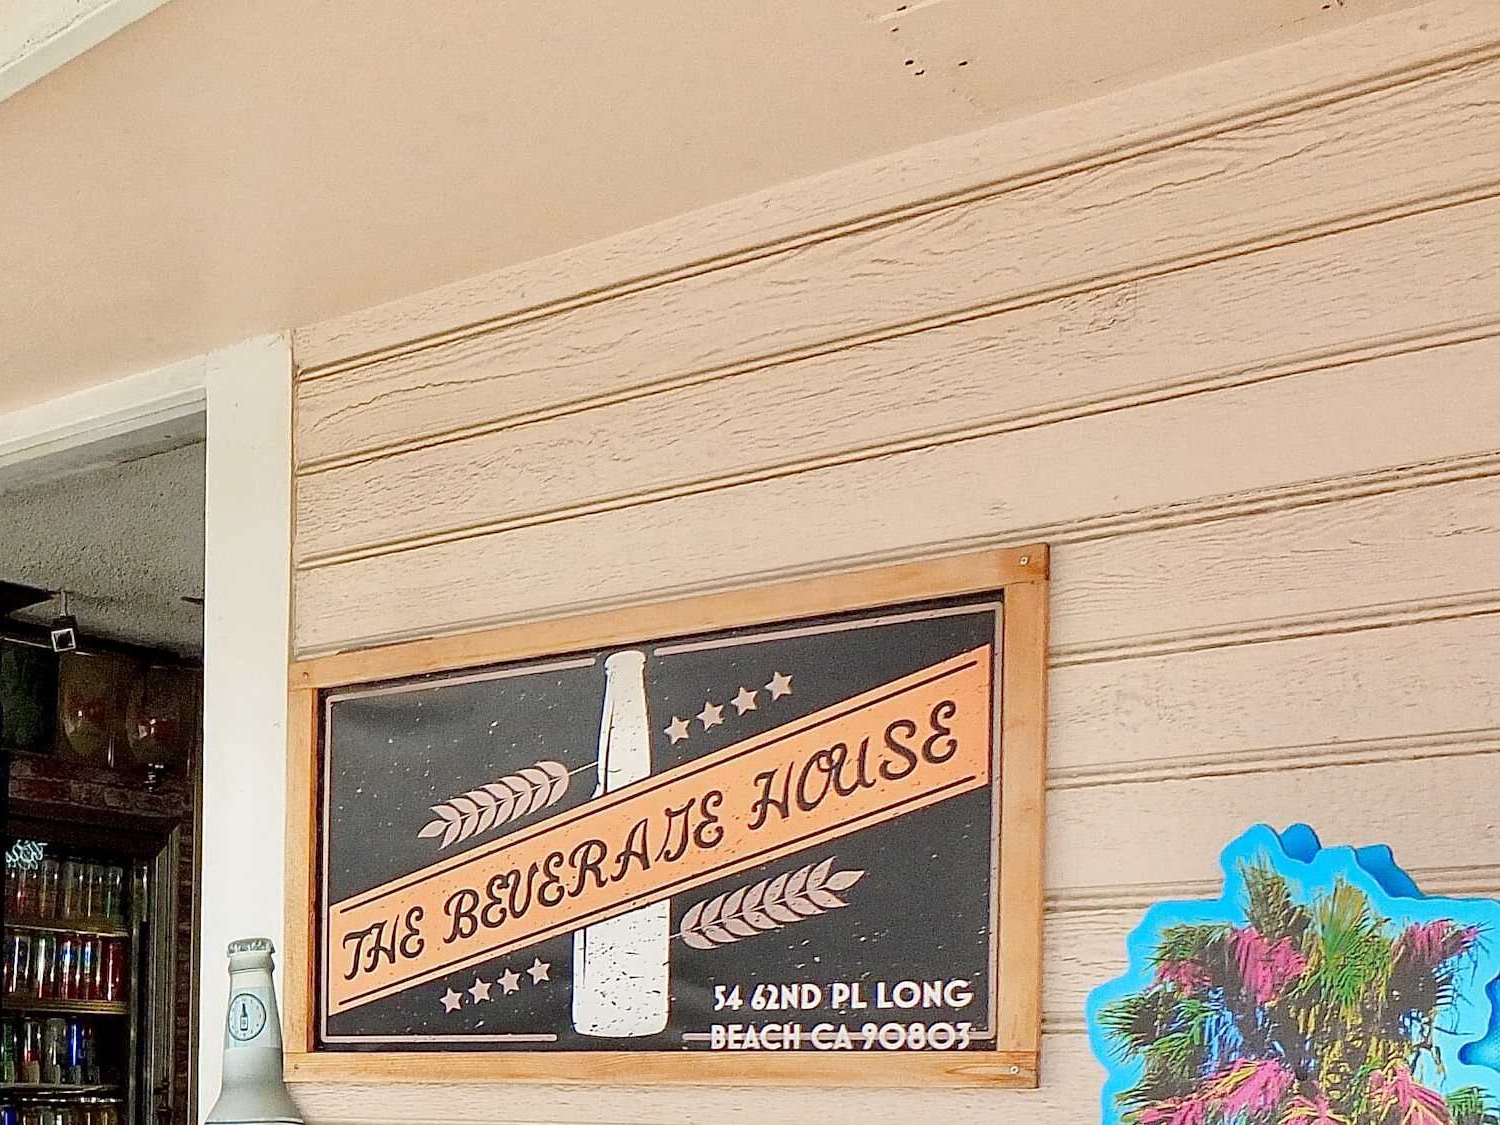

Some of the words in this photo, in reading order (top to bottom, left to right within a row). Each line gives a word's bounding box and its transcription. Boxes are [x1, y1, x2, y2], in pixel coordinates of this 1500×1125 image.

[342, 906, 424, 980] THE
[748, 700, 958, 830] HOUSE
[714, 985, 743, 1010] 54
[751, 983, 822, 1010] 62ND
[832, 982, 867, 1009] PL
[877, 980, 973, 1009] LONG
[711, 1024, 800, 1050] BEACH
[811, 1024, 852, 1050] CA
[862, 1023, 972, 1050] 90803
